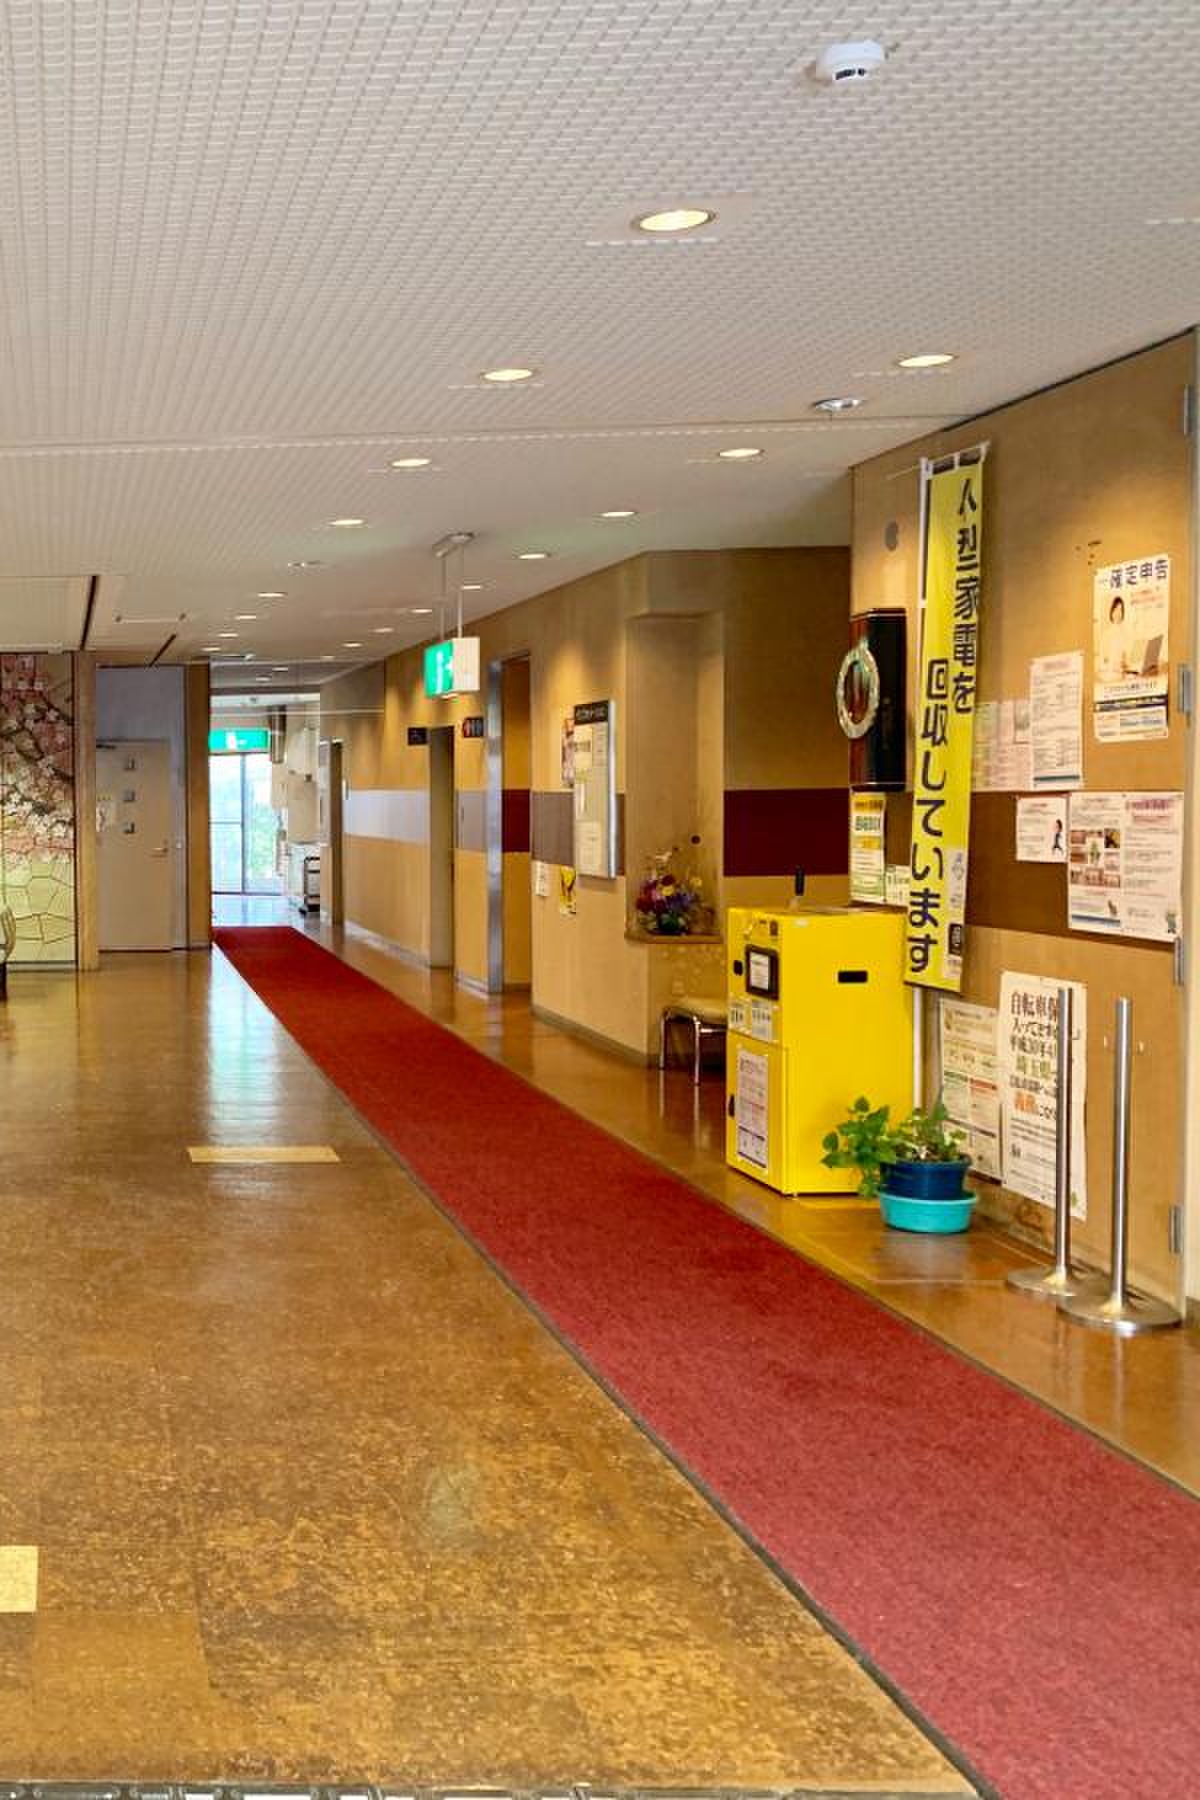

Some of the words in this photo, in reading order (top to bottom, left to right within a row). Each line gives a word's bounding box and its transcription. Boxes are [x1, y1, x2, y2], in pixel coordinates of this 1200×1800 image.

[909, 659, 949, 972] 回収しています
[1010, 990, 1058, 1022] 自転車保
